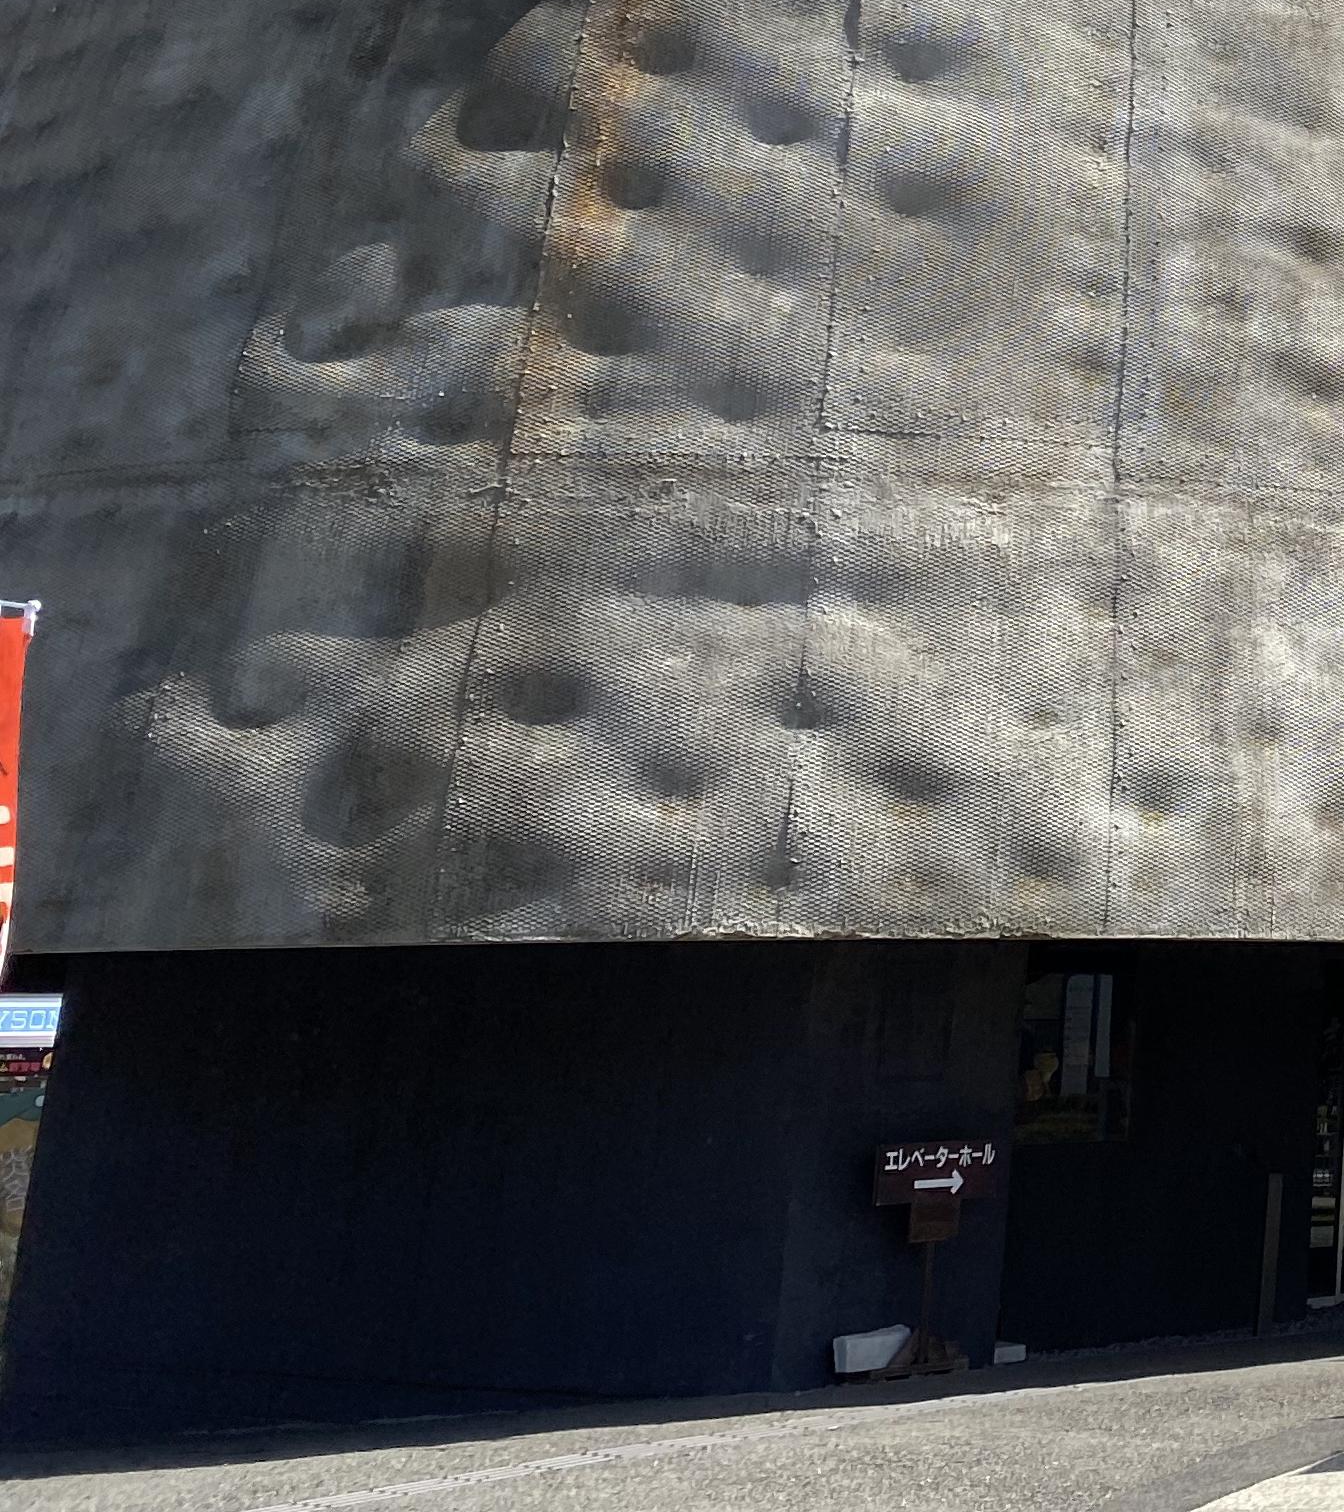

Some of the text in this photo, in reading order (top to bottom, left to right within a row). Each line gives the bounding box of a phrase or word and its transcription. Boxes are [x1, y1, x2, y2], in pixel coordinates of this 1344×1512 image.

[884, 1143, 996, 1170] エレベーターホール
